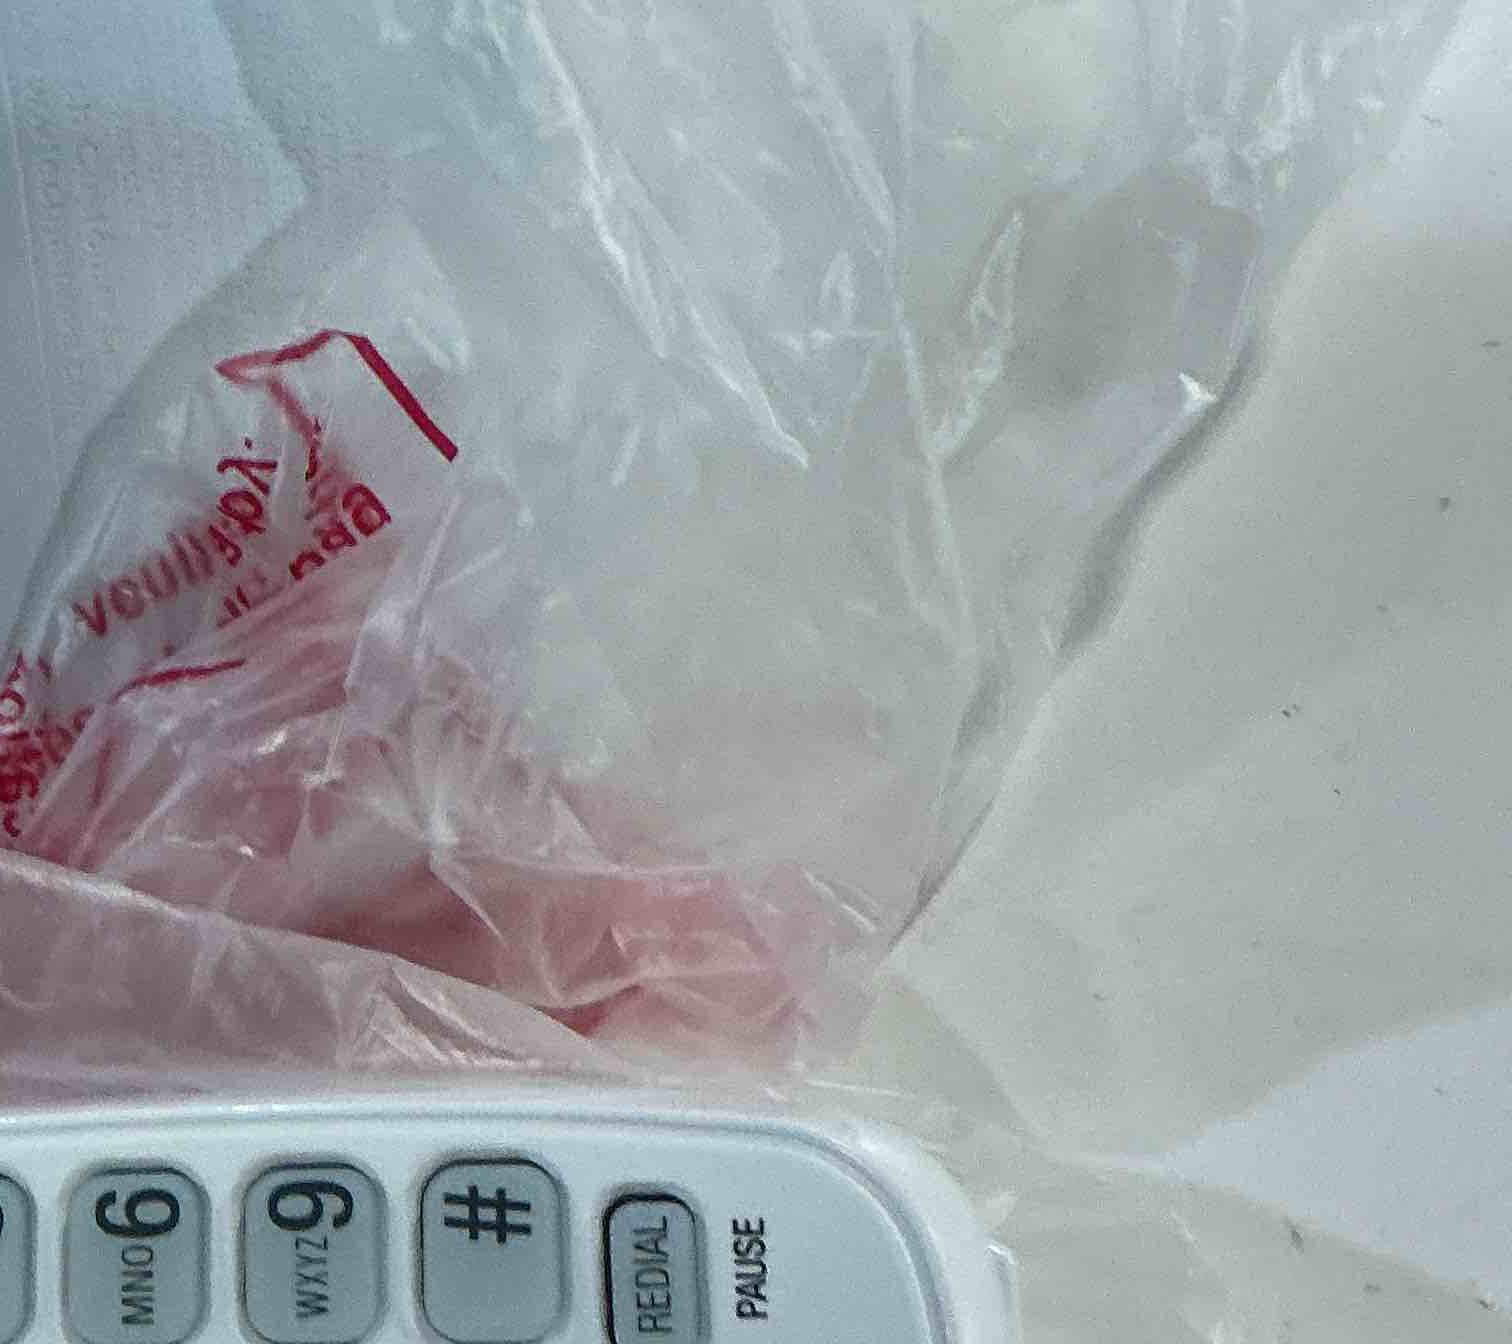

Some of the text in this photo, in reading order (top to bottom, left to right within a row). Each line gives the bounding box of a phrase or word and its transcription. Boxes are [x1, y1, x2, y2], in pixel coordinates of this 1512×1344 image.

[94, 1188, 181, 1327] MNO 6
[267, 1179, 354, 1320] WXYZ 9
[443, 1184, 532, 1245] #
[731, 1215, 769, 1321] PAUSE
[632, 1215, 673, 1335] REDIAL
